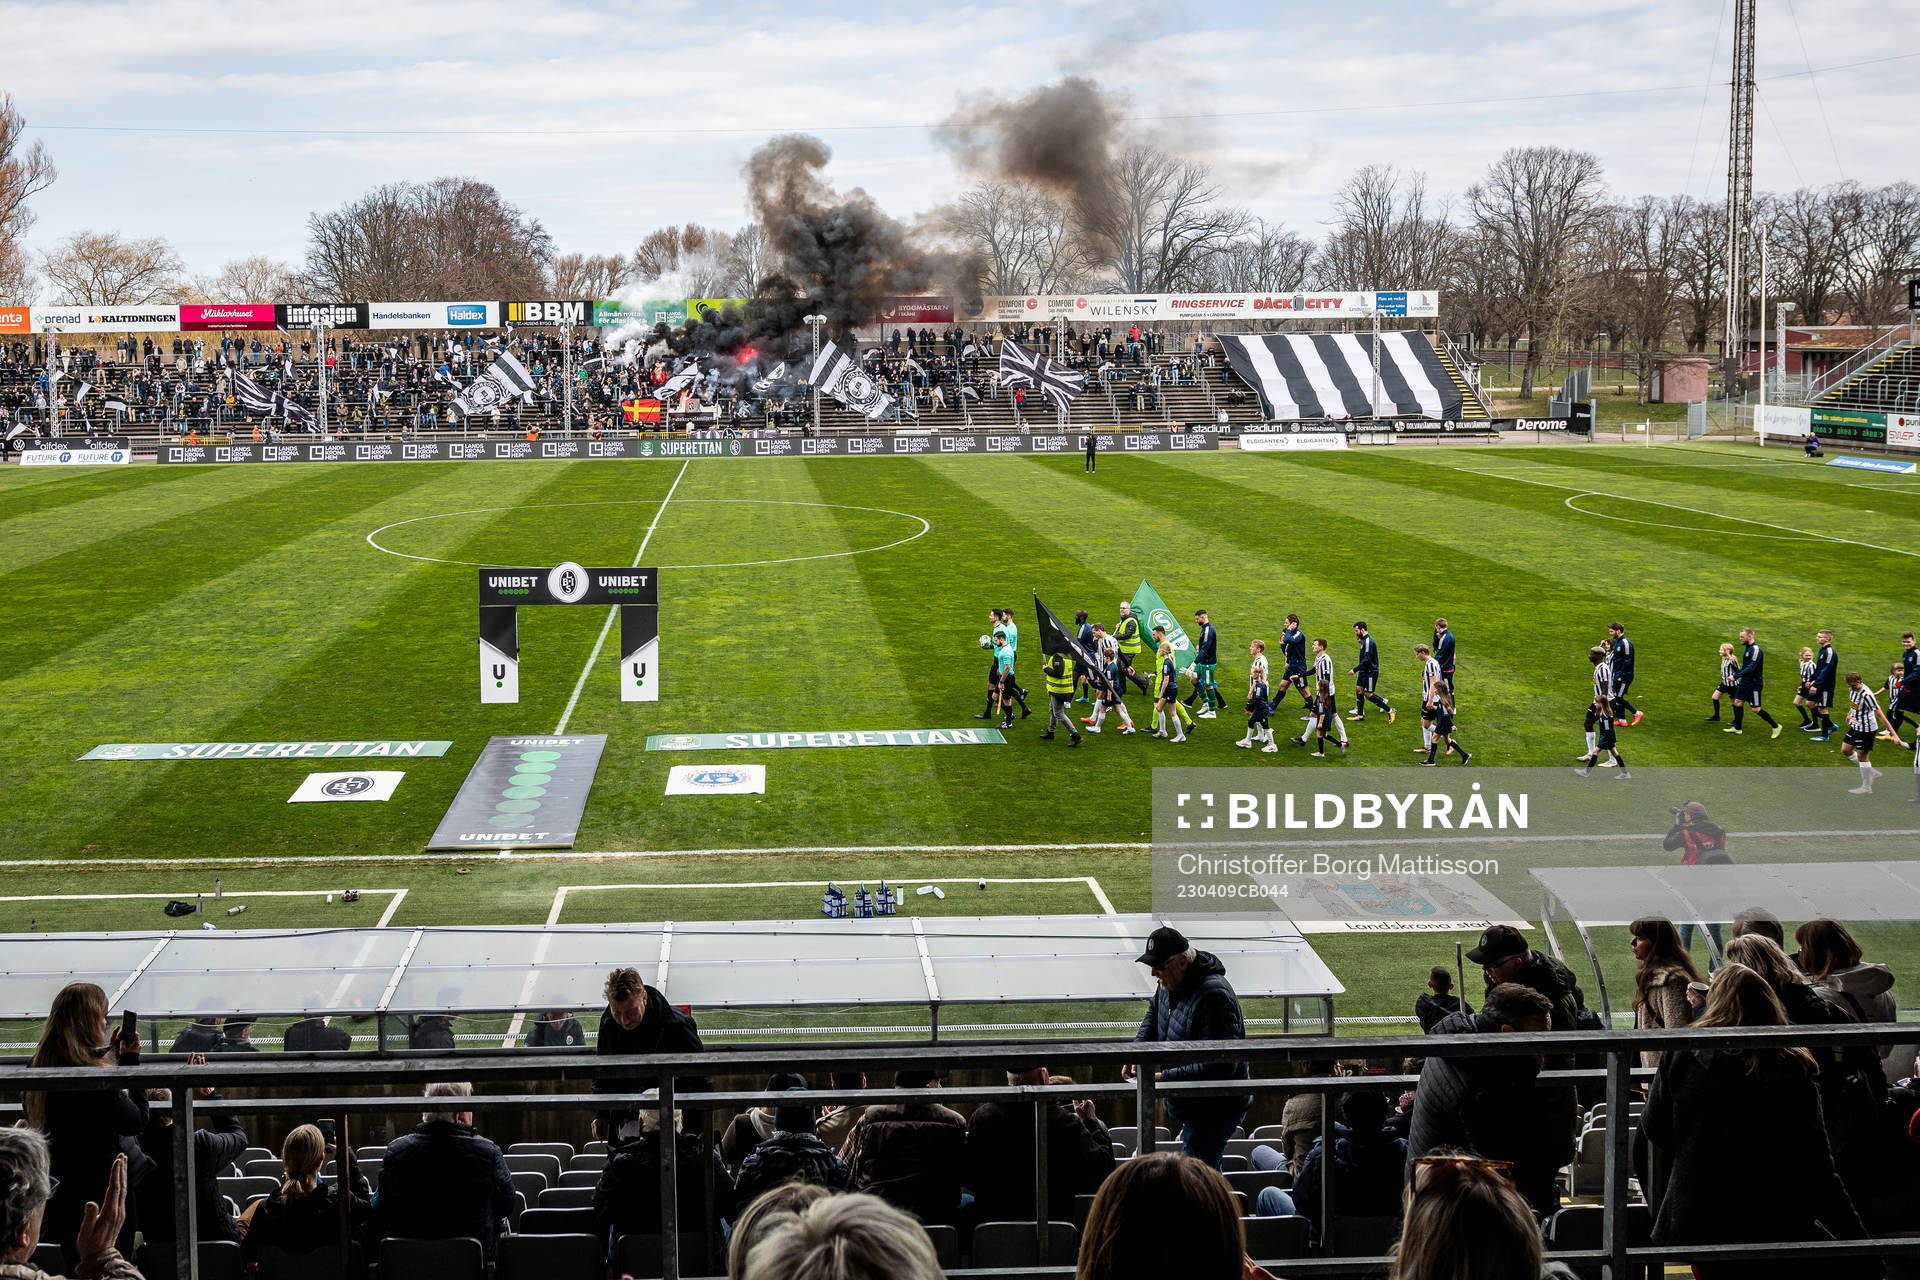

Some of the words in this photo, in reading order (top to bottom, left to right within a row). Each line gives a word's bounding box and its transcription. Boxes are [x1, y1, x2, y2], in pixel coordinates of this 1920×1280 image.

[998, 299, 1025, 307] COMFORT
[1047, 299, 1074, 307] COMFORT
[1171, 299, 1245, 309] RINGSERVICE
[1253, 297, 1293, 309] DÄCK
[1304, 298, 1343, 309] CITY
[286, 305, 358, 324] infosign
[372, 312, 431, 320] Handelsbanken
[450, 310, 484, 320] Haldex
[525, 302, 585, 321] BBM
[1090, 306, 1158, 316] WILENSKY
[0, 313, 23, 323] nta
[88, 315, 176, 323] LOKALTIDNINGEN
[1192, 424, 1231, 433] stadium
[1244, 423, 1283, 433] stadium
[1515, 418, 1567, 431] Derome
[660, 441, 722, 455] SUPERETTAN
[26, 454, 57, 462] FUTURE
[488, 576, 538, 588] UNIBET
[598, 575, 648, 587] UNIBET
[492, 664, 506, 680] U
[633, 662, 646, 679] U
[725, 729, 982, 748] SUPERETTAN
[160, 741, 426, 758] SUPERETTAN
[459, 832, 550, 841] UNIBET
[1345, 921, 1450, 931] Landskrona
[1456, 920, 1495, 929] stad
